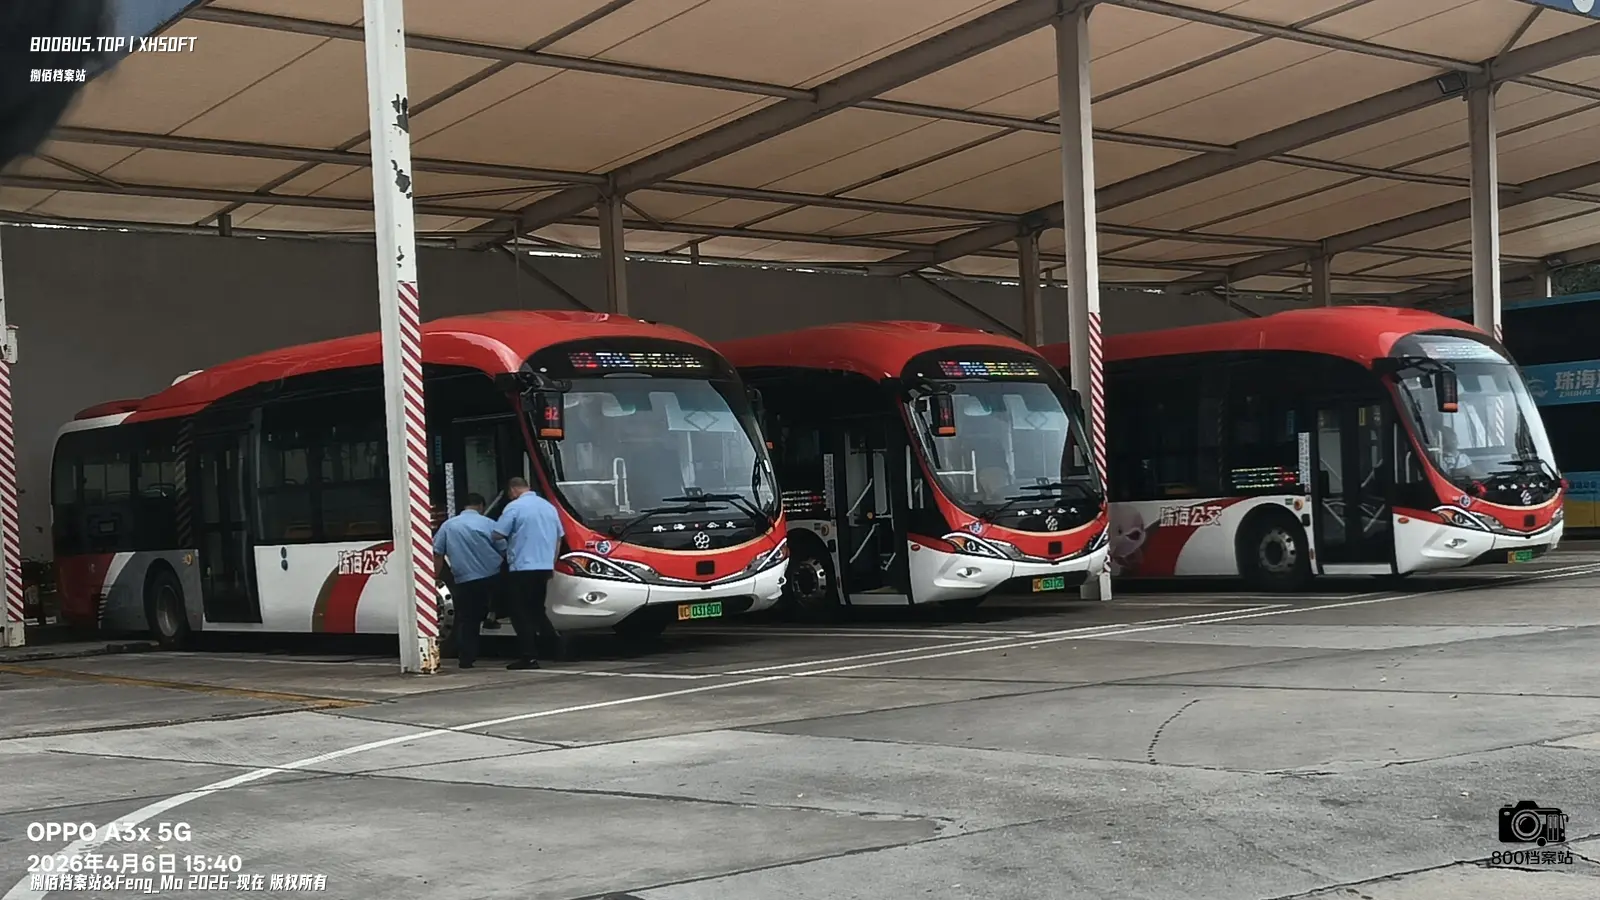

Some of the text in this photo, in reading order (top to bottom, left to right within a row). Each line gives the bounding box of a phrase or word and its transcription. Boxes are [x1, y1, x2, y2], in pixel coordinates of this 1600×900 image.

[1554, 369, 1600, 391] 珠海
[1159, 505, 1222, 527] 珠海公交
[338, 550, 388, 575] 珠海公交
